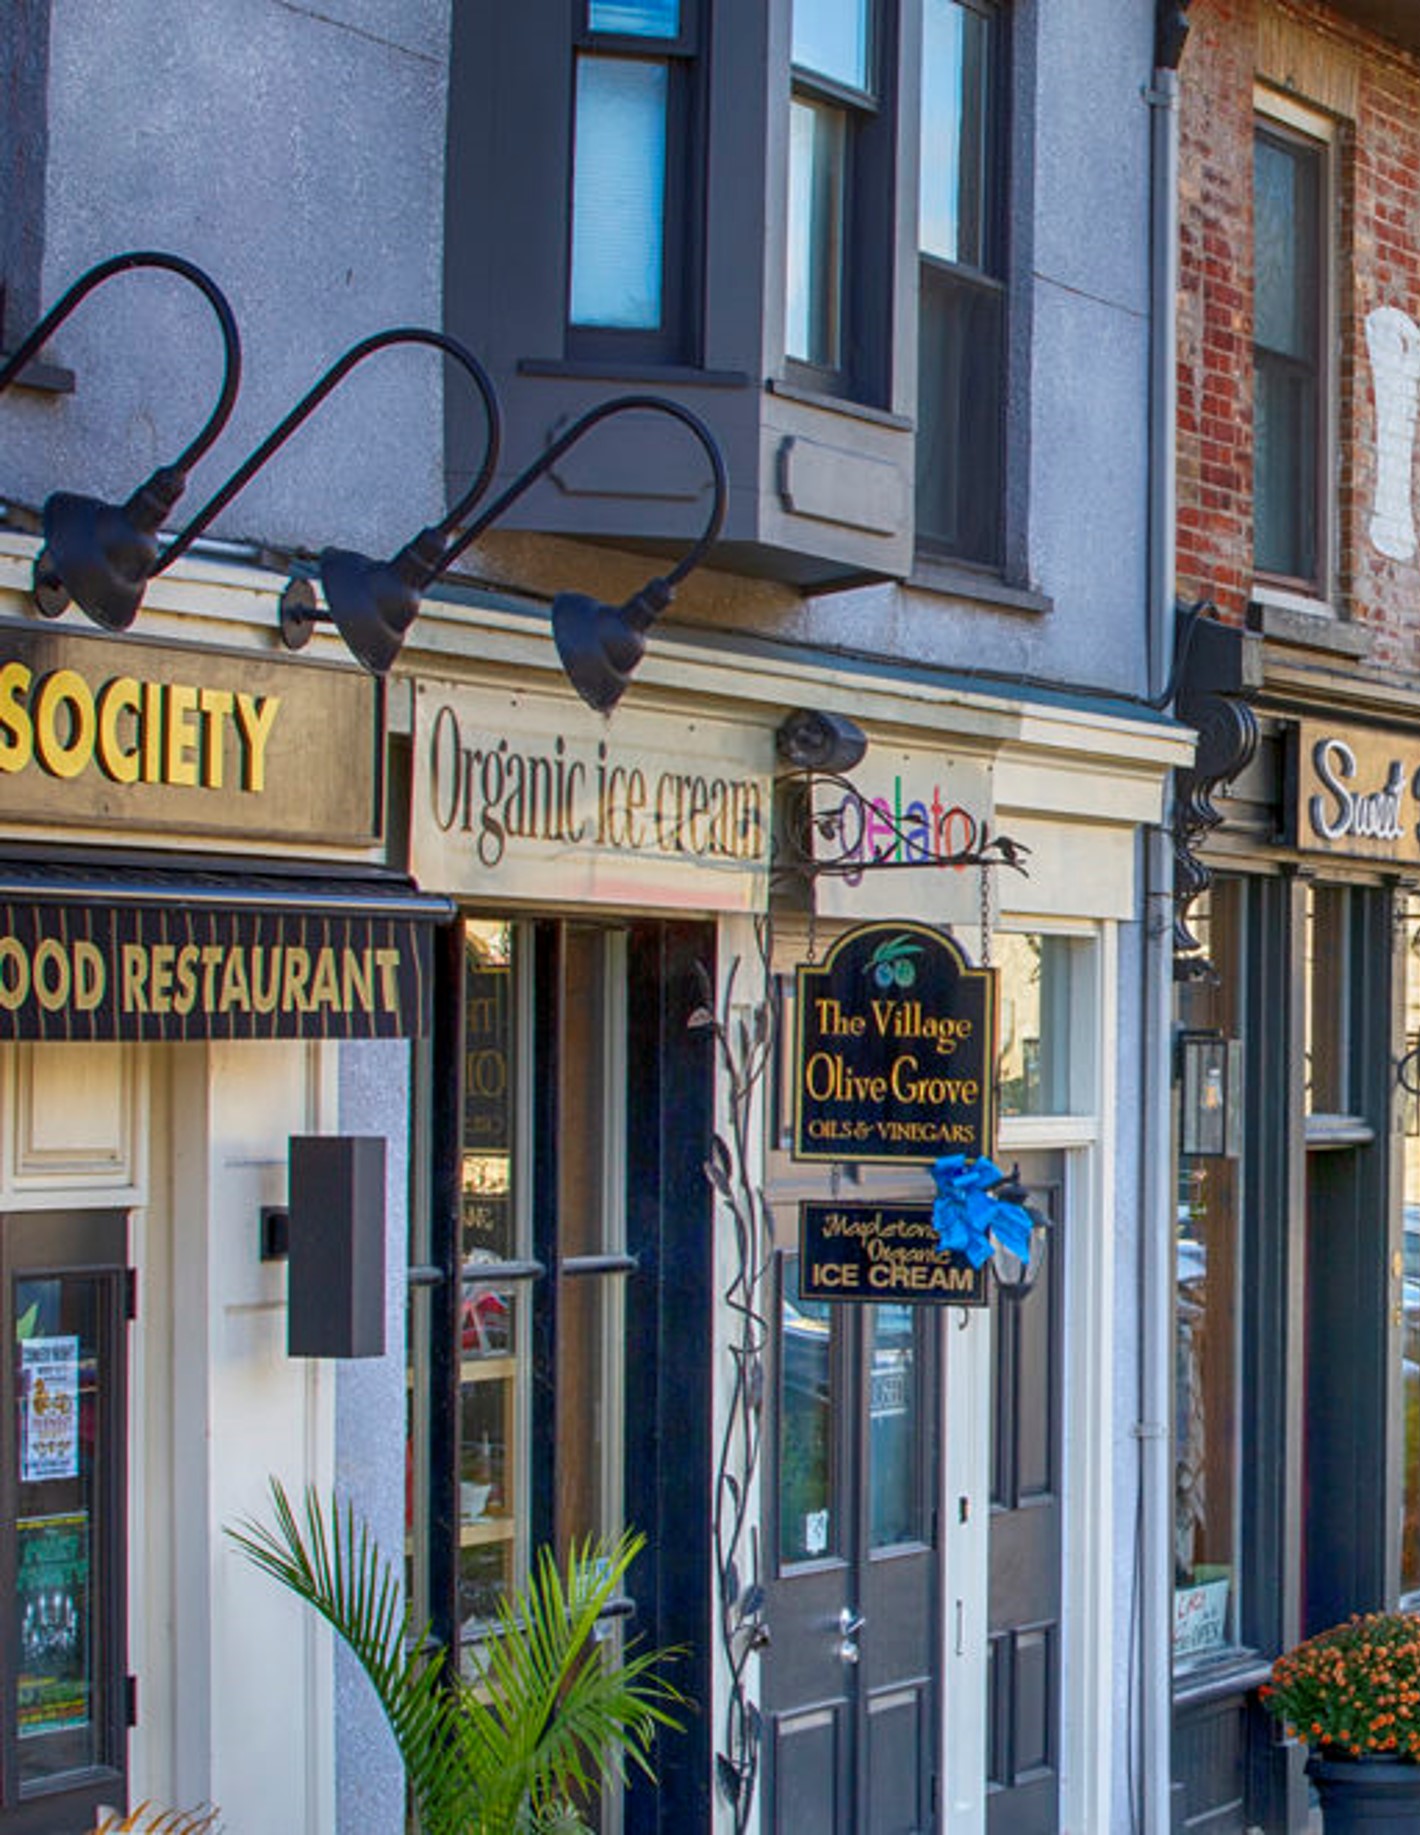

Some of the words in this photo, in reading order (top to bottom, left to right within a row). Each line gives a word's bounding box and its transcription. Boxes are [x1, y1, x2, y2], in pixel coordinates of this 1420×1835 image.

[0, 661, 281, 792] SOCIETY
[430, 705, 586, 867] Organic
[595, 740, 648, 848] ice
[656, 771, 763, 860] cream
[1309, 738, 1405, 841] Sweet
[840, 775, 976, 888] gelato
[122, 944, 400, 1015] RESTAURANT
[815, 997, 866, 1036] The
[871, 1000, 973, 1055] Village
[806, 1052, 888, 1103] Olive
[892, 1055, 979, 1105] Grove
[877, 1122, 976, 1144] VINEGARS
[812, 1263, 859, 1287] ICE
[868, 1264, 974, 1291] CREAM
